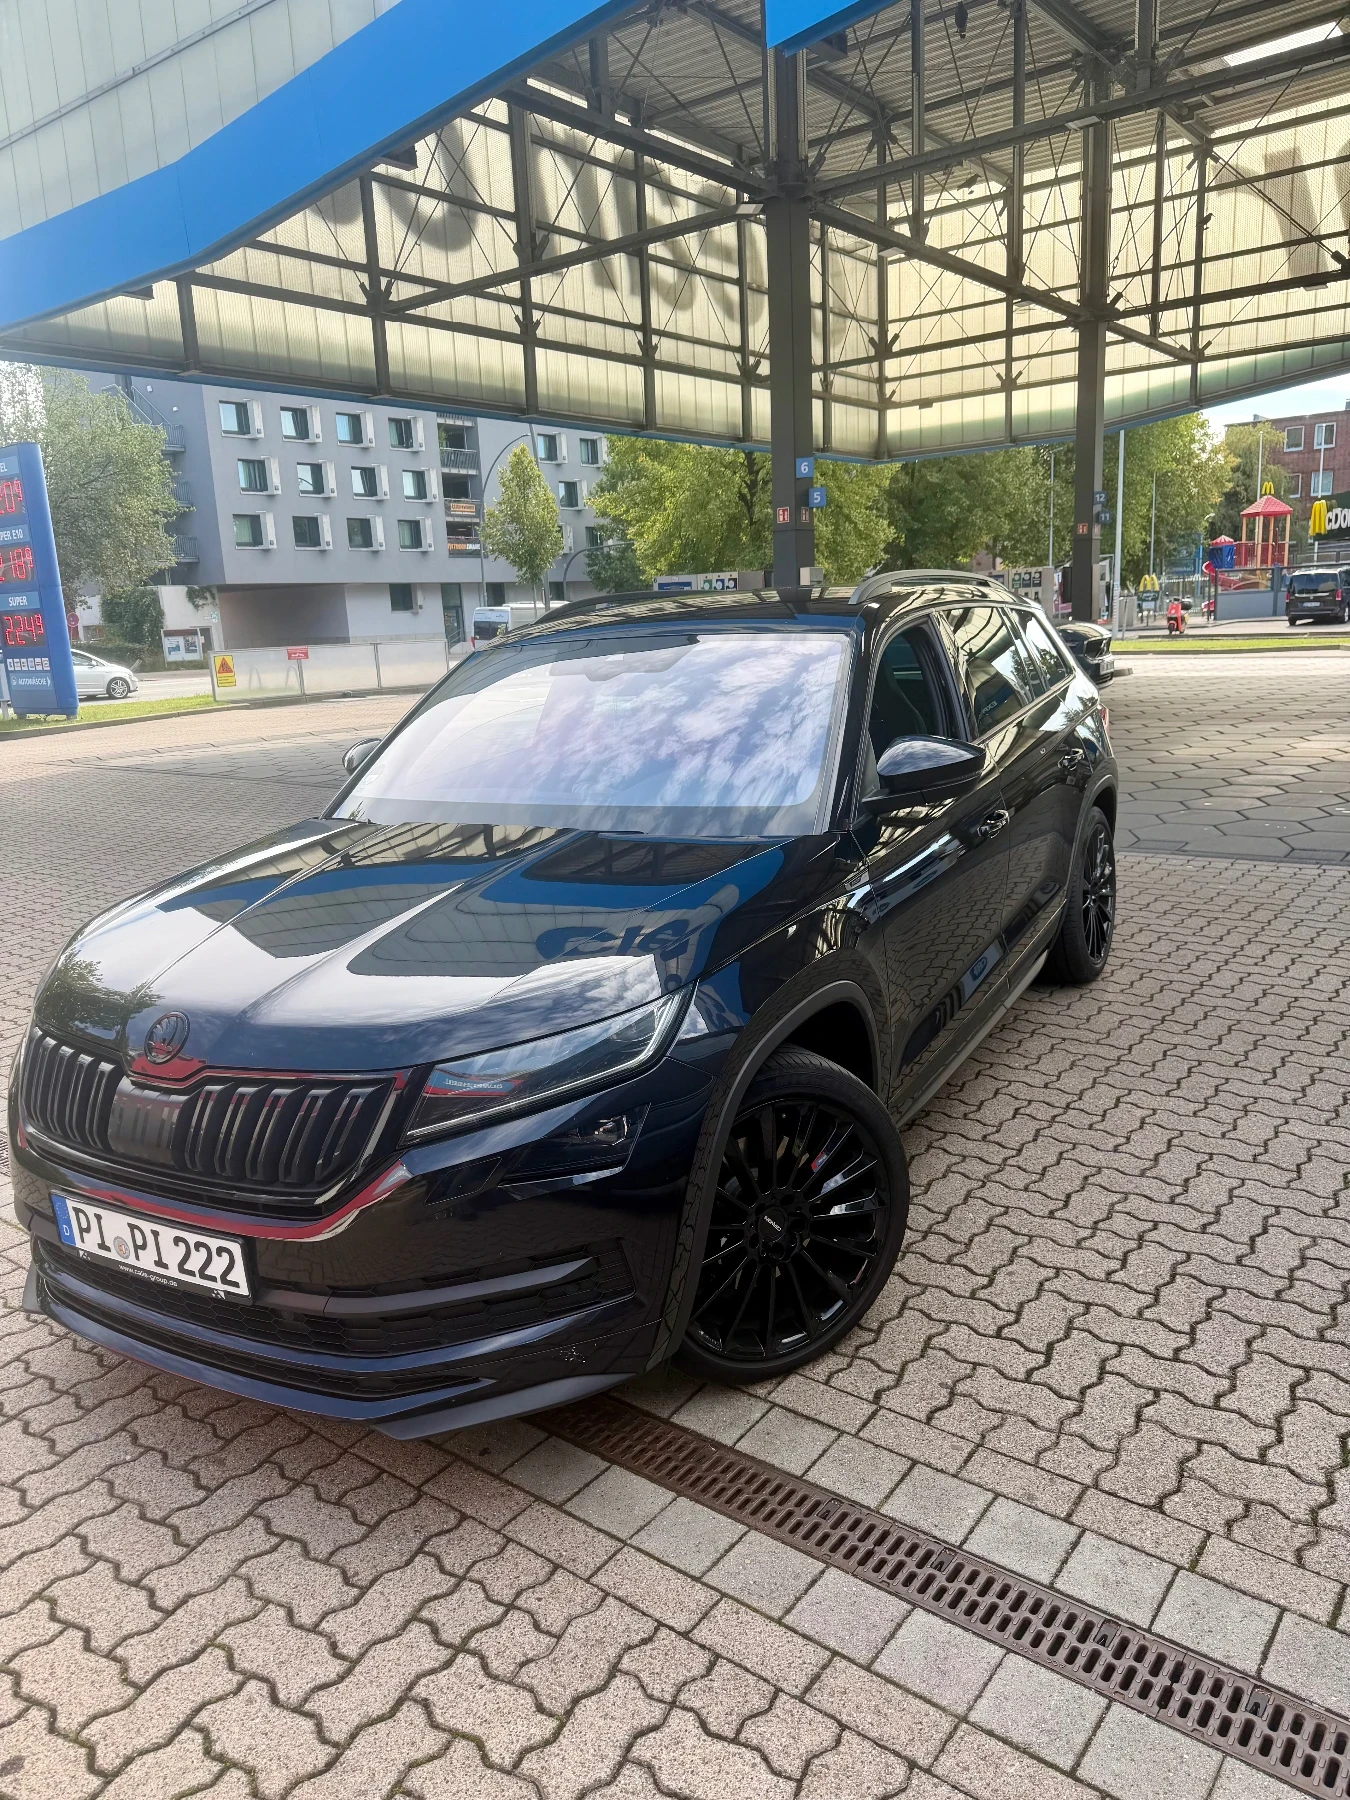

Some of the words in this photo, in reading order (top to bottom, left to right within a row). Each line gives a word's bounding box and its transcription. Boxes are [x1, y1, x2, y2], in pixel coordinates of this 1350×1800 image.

[800, 462, 809, 474] 6
[813, 492, 821, 503] 5
[1094, 493, 1106, 502] 12
[1100, 512, 1110, 521] 11
[12, 528, 24, 540] E10
[8, 595, 28, 607] SUPER
[63, 1224, 70, 1236] D
[72, 1206, 111, 1253] PI
[127, 1222, 169, 1270] PI
[172, 1235, 240, 1289] 222
